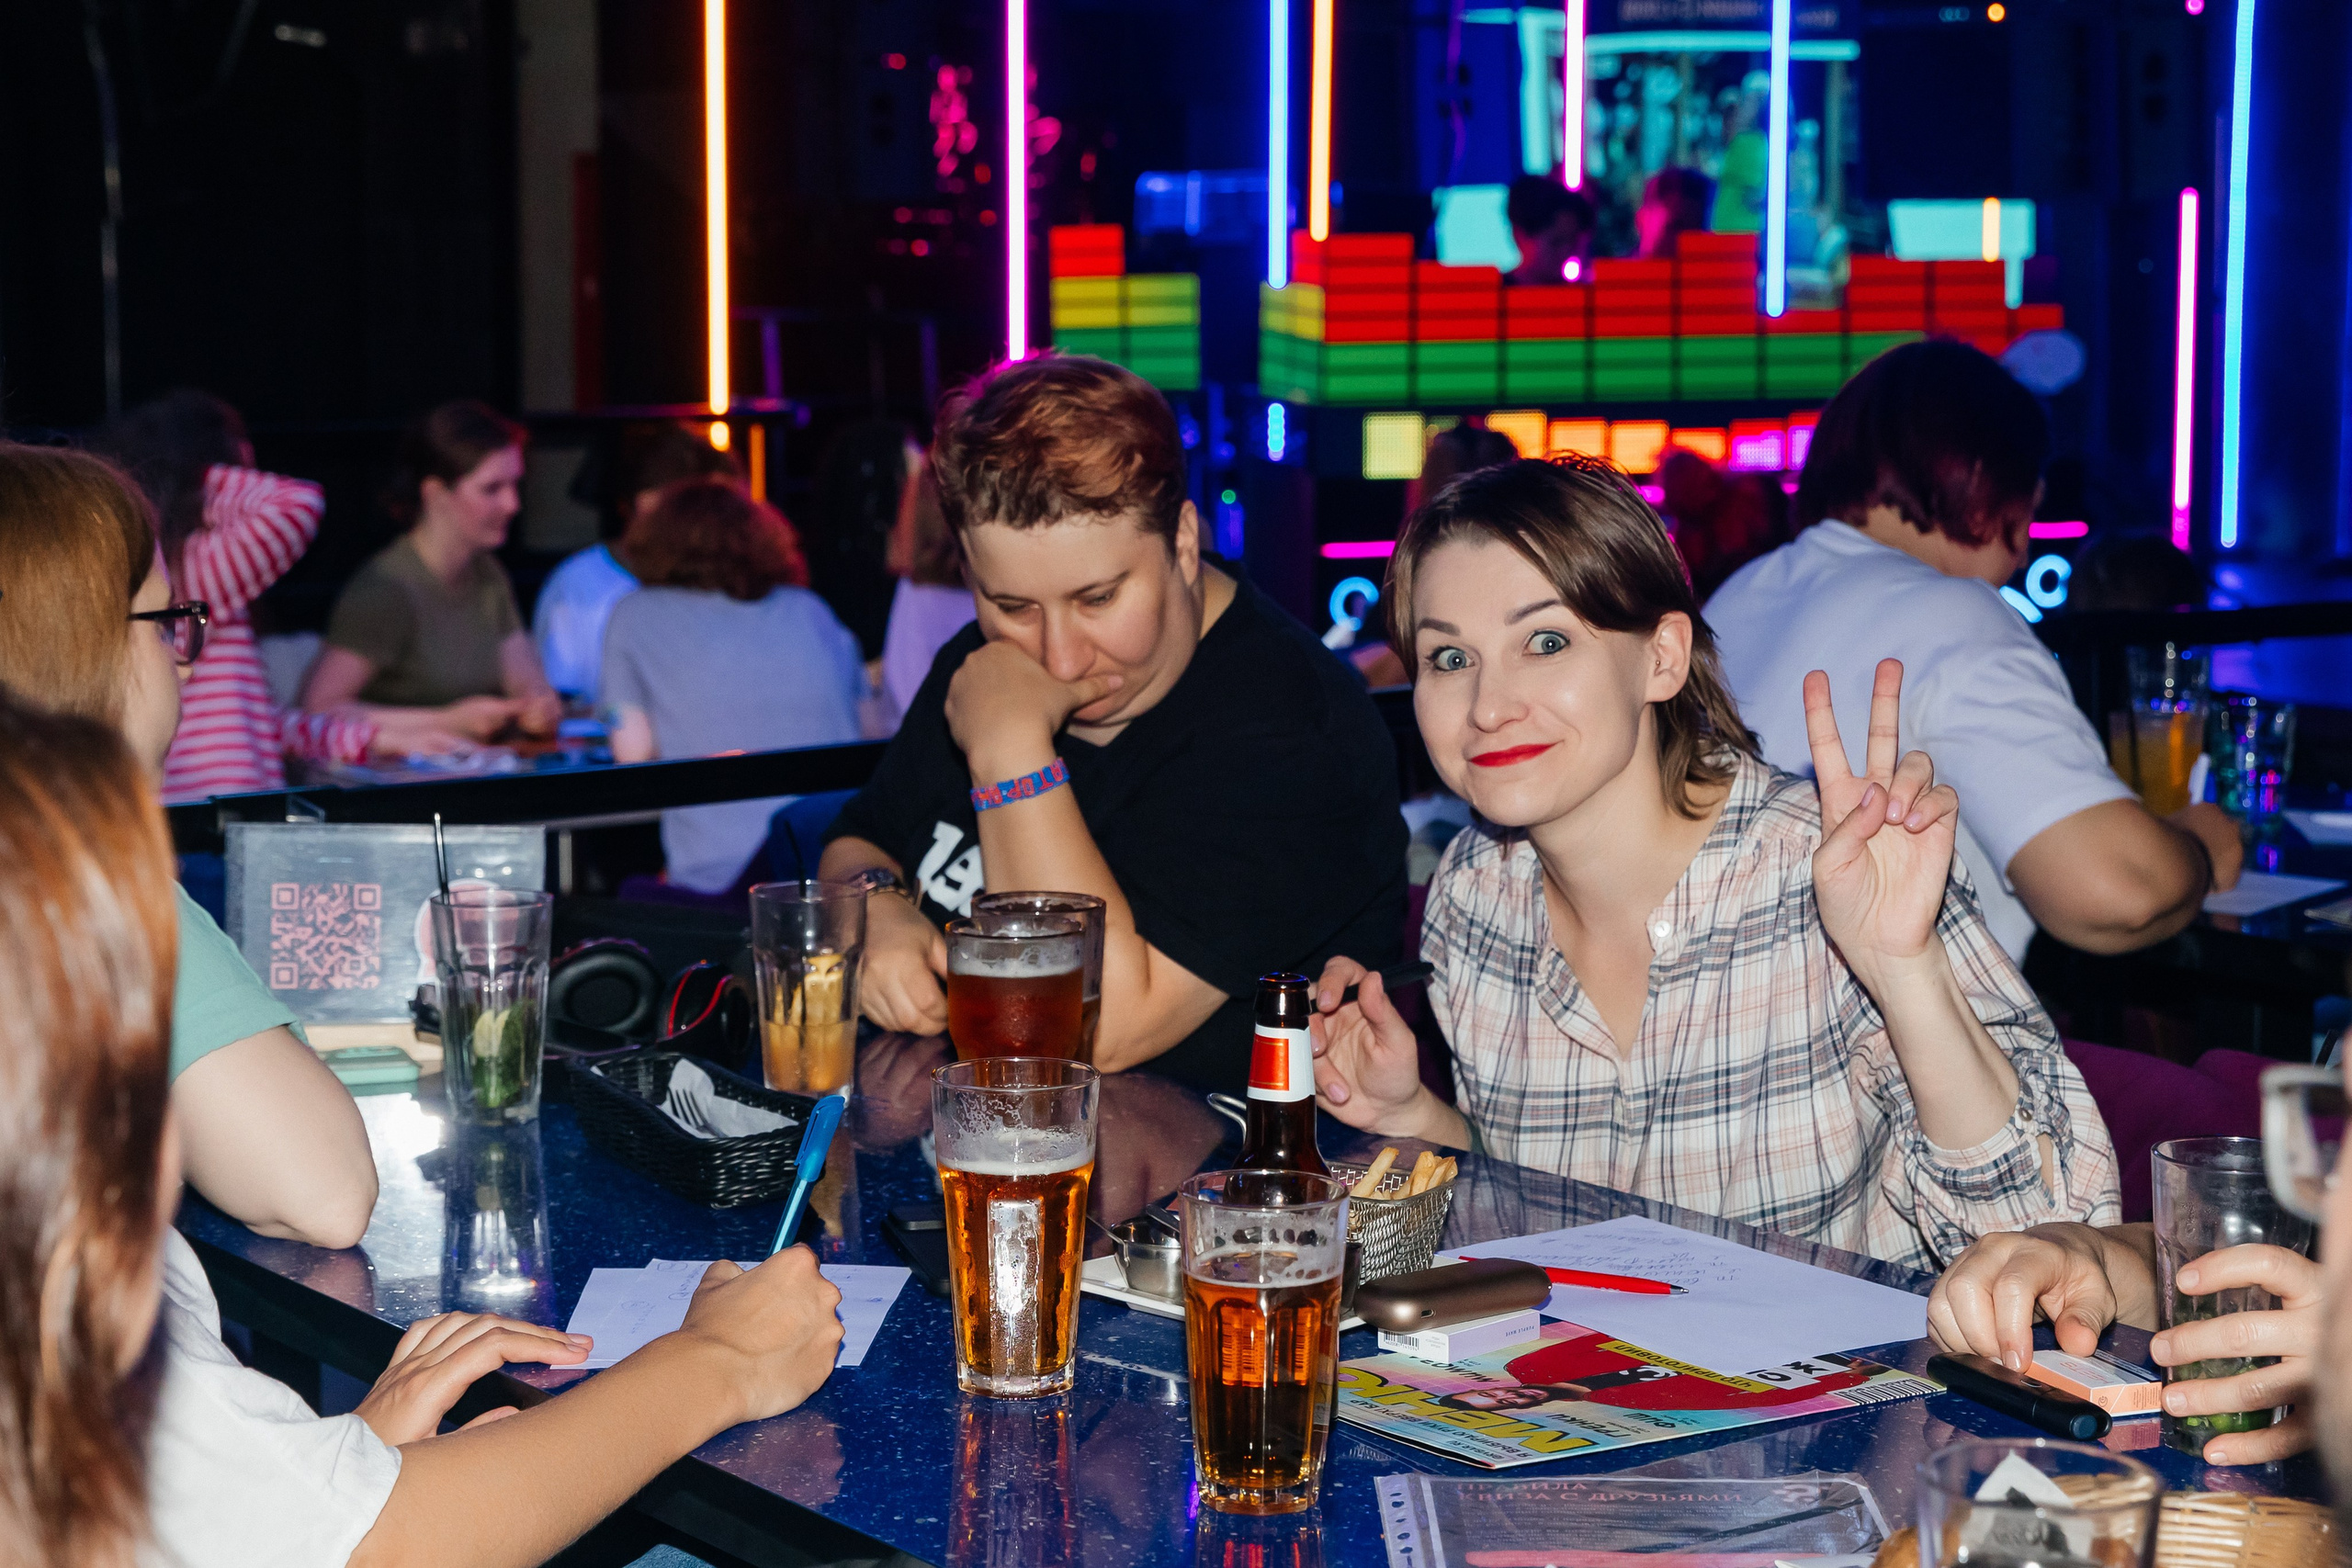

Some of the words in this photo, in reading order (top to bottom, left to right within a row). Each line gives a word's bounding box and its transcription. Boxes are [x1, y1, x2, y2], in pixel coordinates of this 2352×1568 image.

[1519, 1325, 1534, 1334] PURPLE
[1409, 1356, 1499, 1382] МИМОЗ
[1614, 1344, 1718, 1381] ПРИГОТОВИЛ
[1720, 1377, 1752, 1388] ЧТО
[1338, 1367, 1598, 1453] МЕНЮ
[1350, 1399, 1379, 1409] БАР
[1374, 1406, 1421, 1422] ВВЕРХ!
[1623, 1413, 1676, 1428] ФИШ
[1419, 1420, 1454, 1433] РУКИ
[1545, 1413, 1631, 1438] ГРЕНКИ
[1453, 1431, 1522, 1455] ВЫБИРАЮ
[1456, 1482, 1588, 1491] ПРАВИЛА
[1458, 1492, 1552, 1502] КВИЗА
[1560, 1493, 1578, 1501] С
[1589, 1493, 1742, 1502] ДРУЗЬЯМИ
